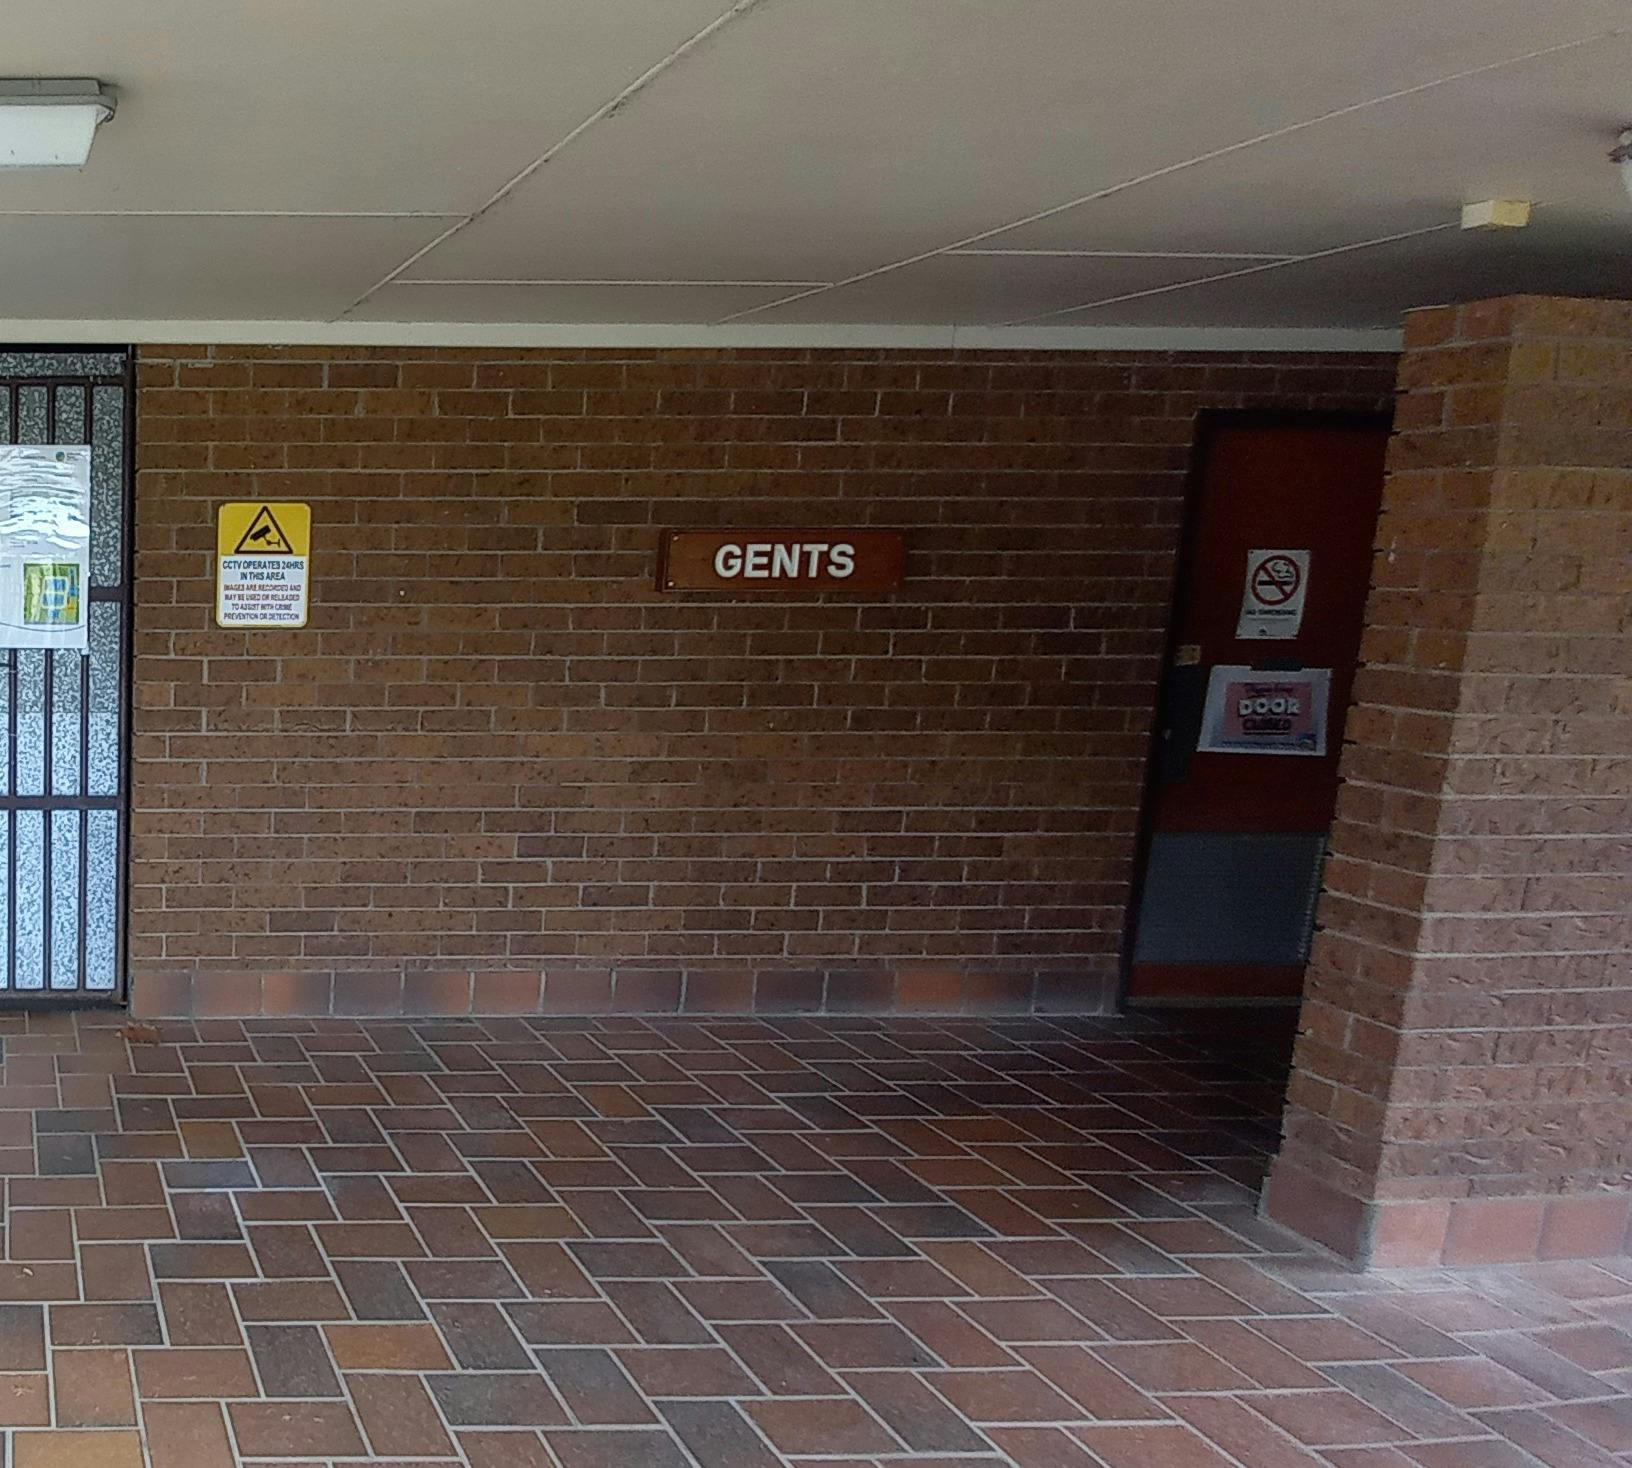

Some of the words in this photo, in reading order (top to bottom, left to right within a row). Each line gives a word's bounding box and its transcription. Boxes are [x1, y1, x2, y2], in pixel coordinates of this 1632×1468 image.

[714, 543, 855, 578] GENTS
[223, 561, 242, 569] CCTV
[243, 561, 280, 570] OPERATES
[282, 561, 305, 570] 24HRS
[240, 572, 247, 580] IN
[249, 572, 264, 580] THIS
[266, 572, 286, 580] AREA
[223, 612, 258, 620] PREVENTION
[259, 612, 268, 620] OR
[268, 612, 299, 620] DETECTION
[1238, 697, 1301, 716] DOOR
